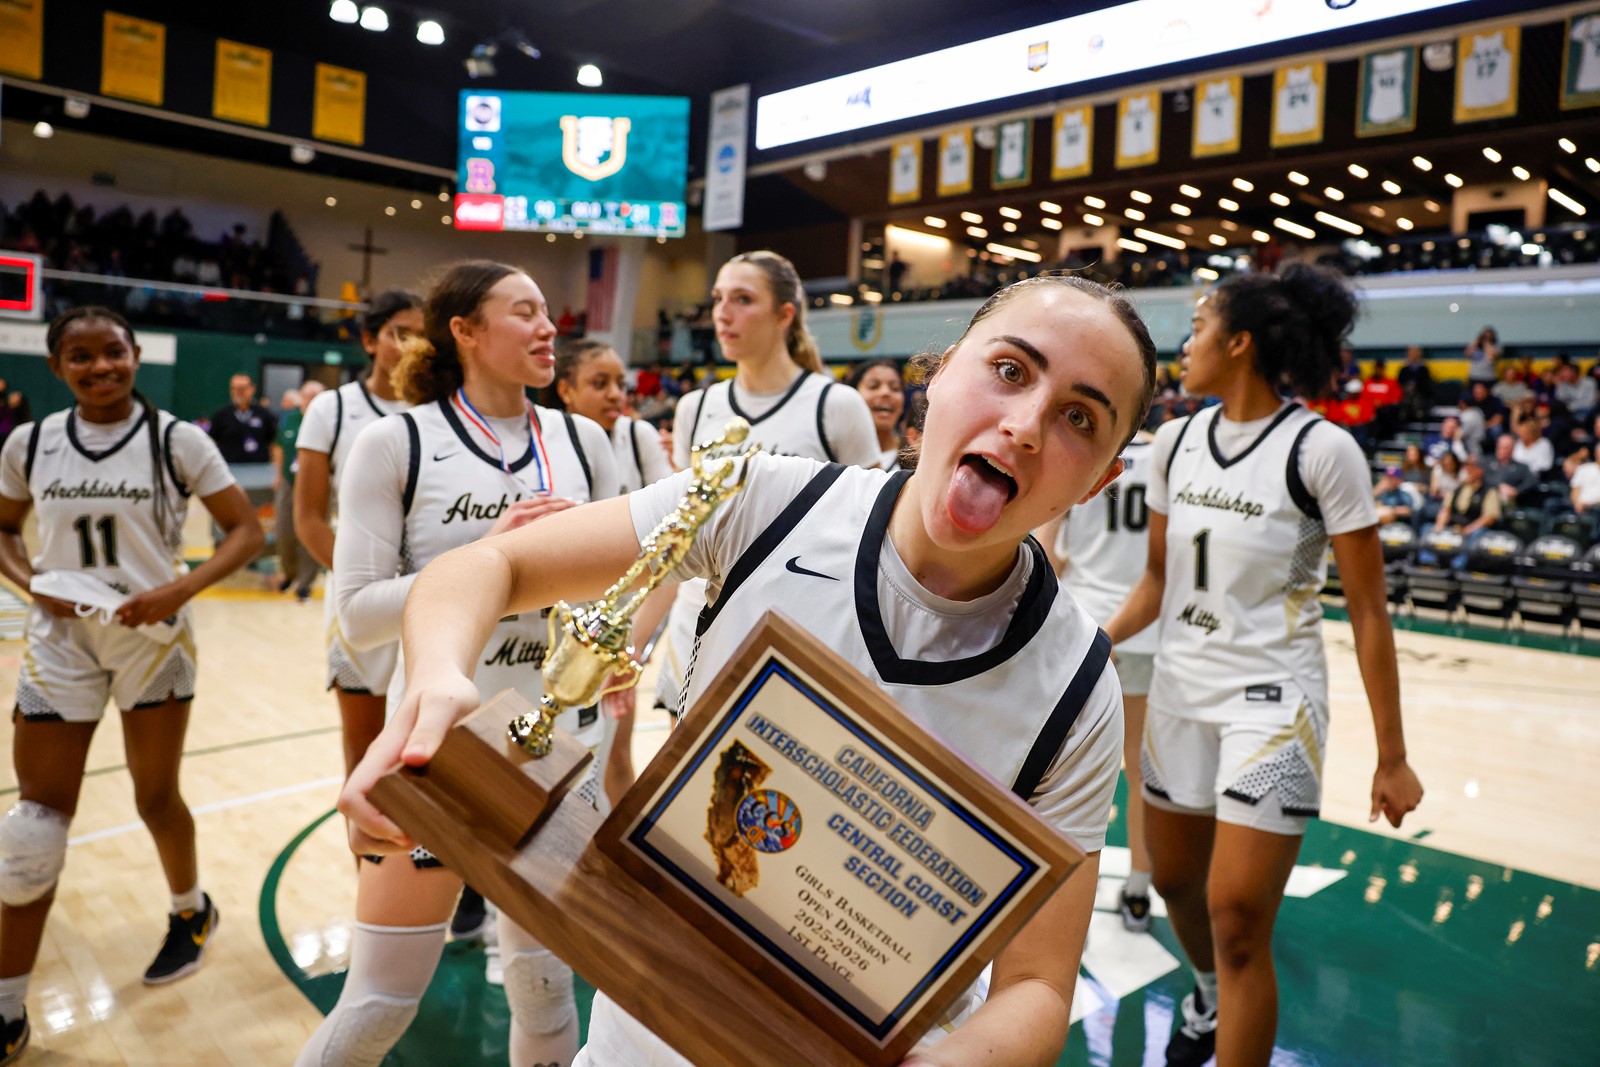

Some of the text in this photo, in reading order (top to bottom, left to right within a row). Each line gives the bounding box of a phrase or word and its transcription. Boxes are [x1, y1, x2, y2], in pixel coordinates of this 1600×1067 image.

[42, 479, 151, 505] Archbishop
[1104, 483, 1148, 532] 10
[1174, 482, 1264, 521] Archbishop
[73, 514, 119, 568] 11
[1193, 528, 1211, 592] 1
[1176, 603, 1221, 636] Mitty
[485, 636, 550, 669] Mitty
[747, 714, 984, 905] INTERSCHOLASTIC FEDERATION
[837, 746, 934, 829] CALIFORNIA
[827, 813, 967, 925] CENTRAL COAST
[843, 855, 920, 918] SECTION
[794, 908, 870, 971] 2025-2026
[795, 865, 912, 964] GIRLS BASKETBALL
[798, 889, 890, 965] OPEN DIVISION
[812, 945, 855, 982] PLACE
